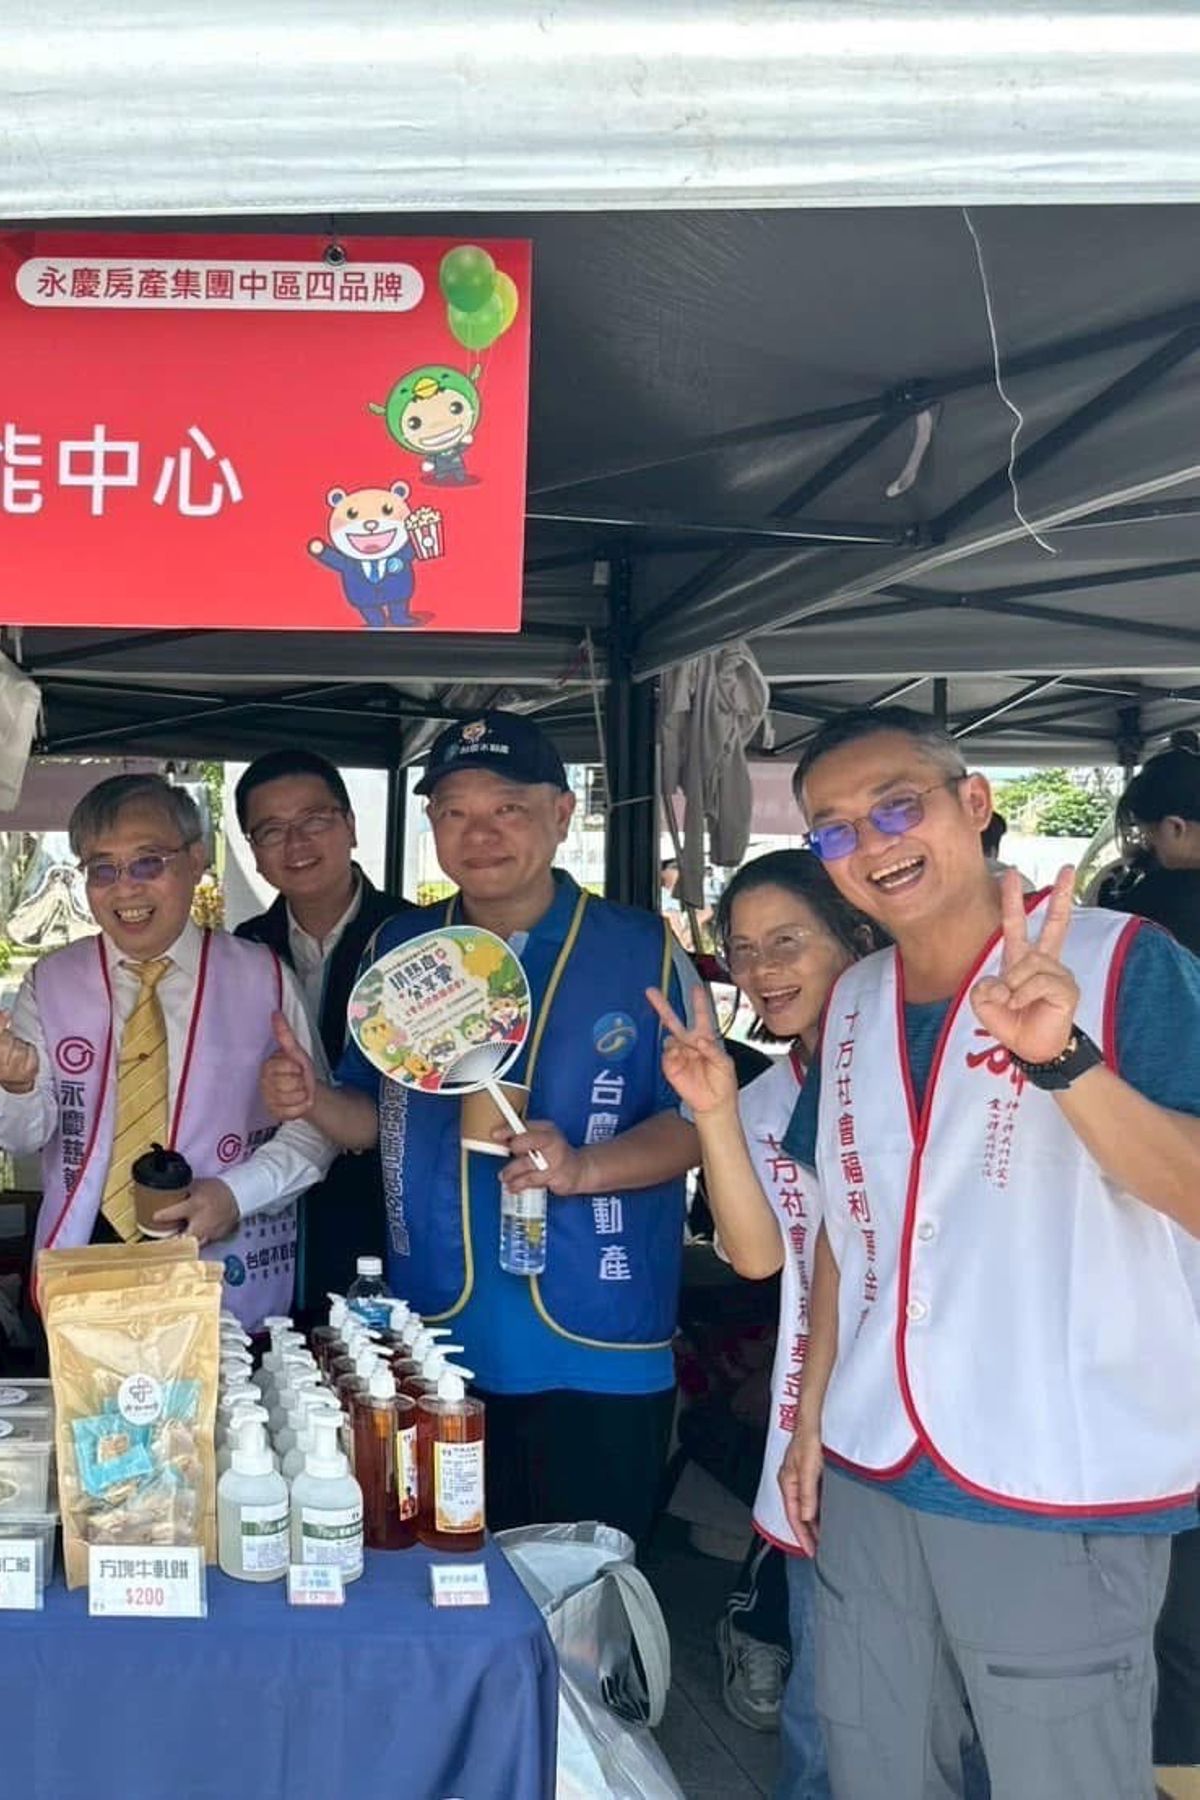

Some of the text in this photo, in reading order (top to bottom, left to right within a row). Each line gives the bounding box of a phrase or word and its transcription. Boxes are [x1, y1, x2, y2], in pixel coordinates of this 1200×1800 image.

[35, 265, 404, 303] 永慶房產集團中區四品牌
[125, 1586, 164, 1606] $200
